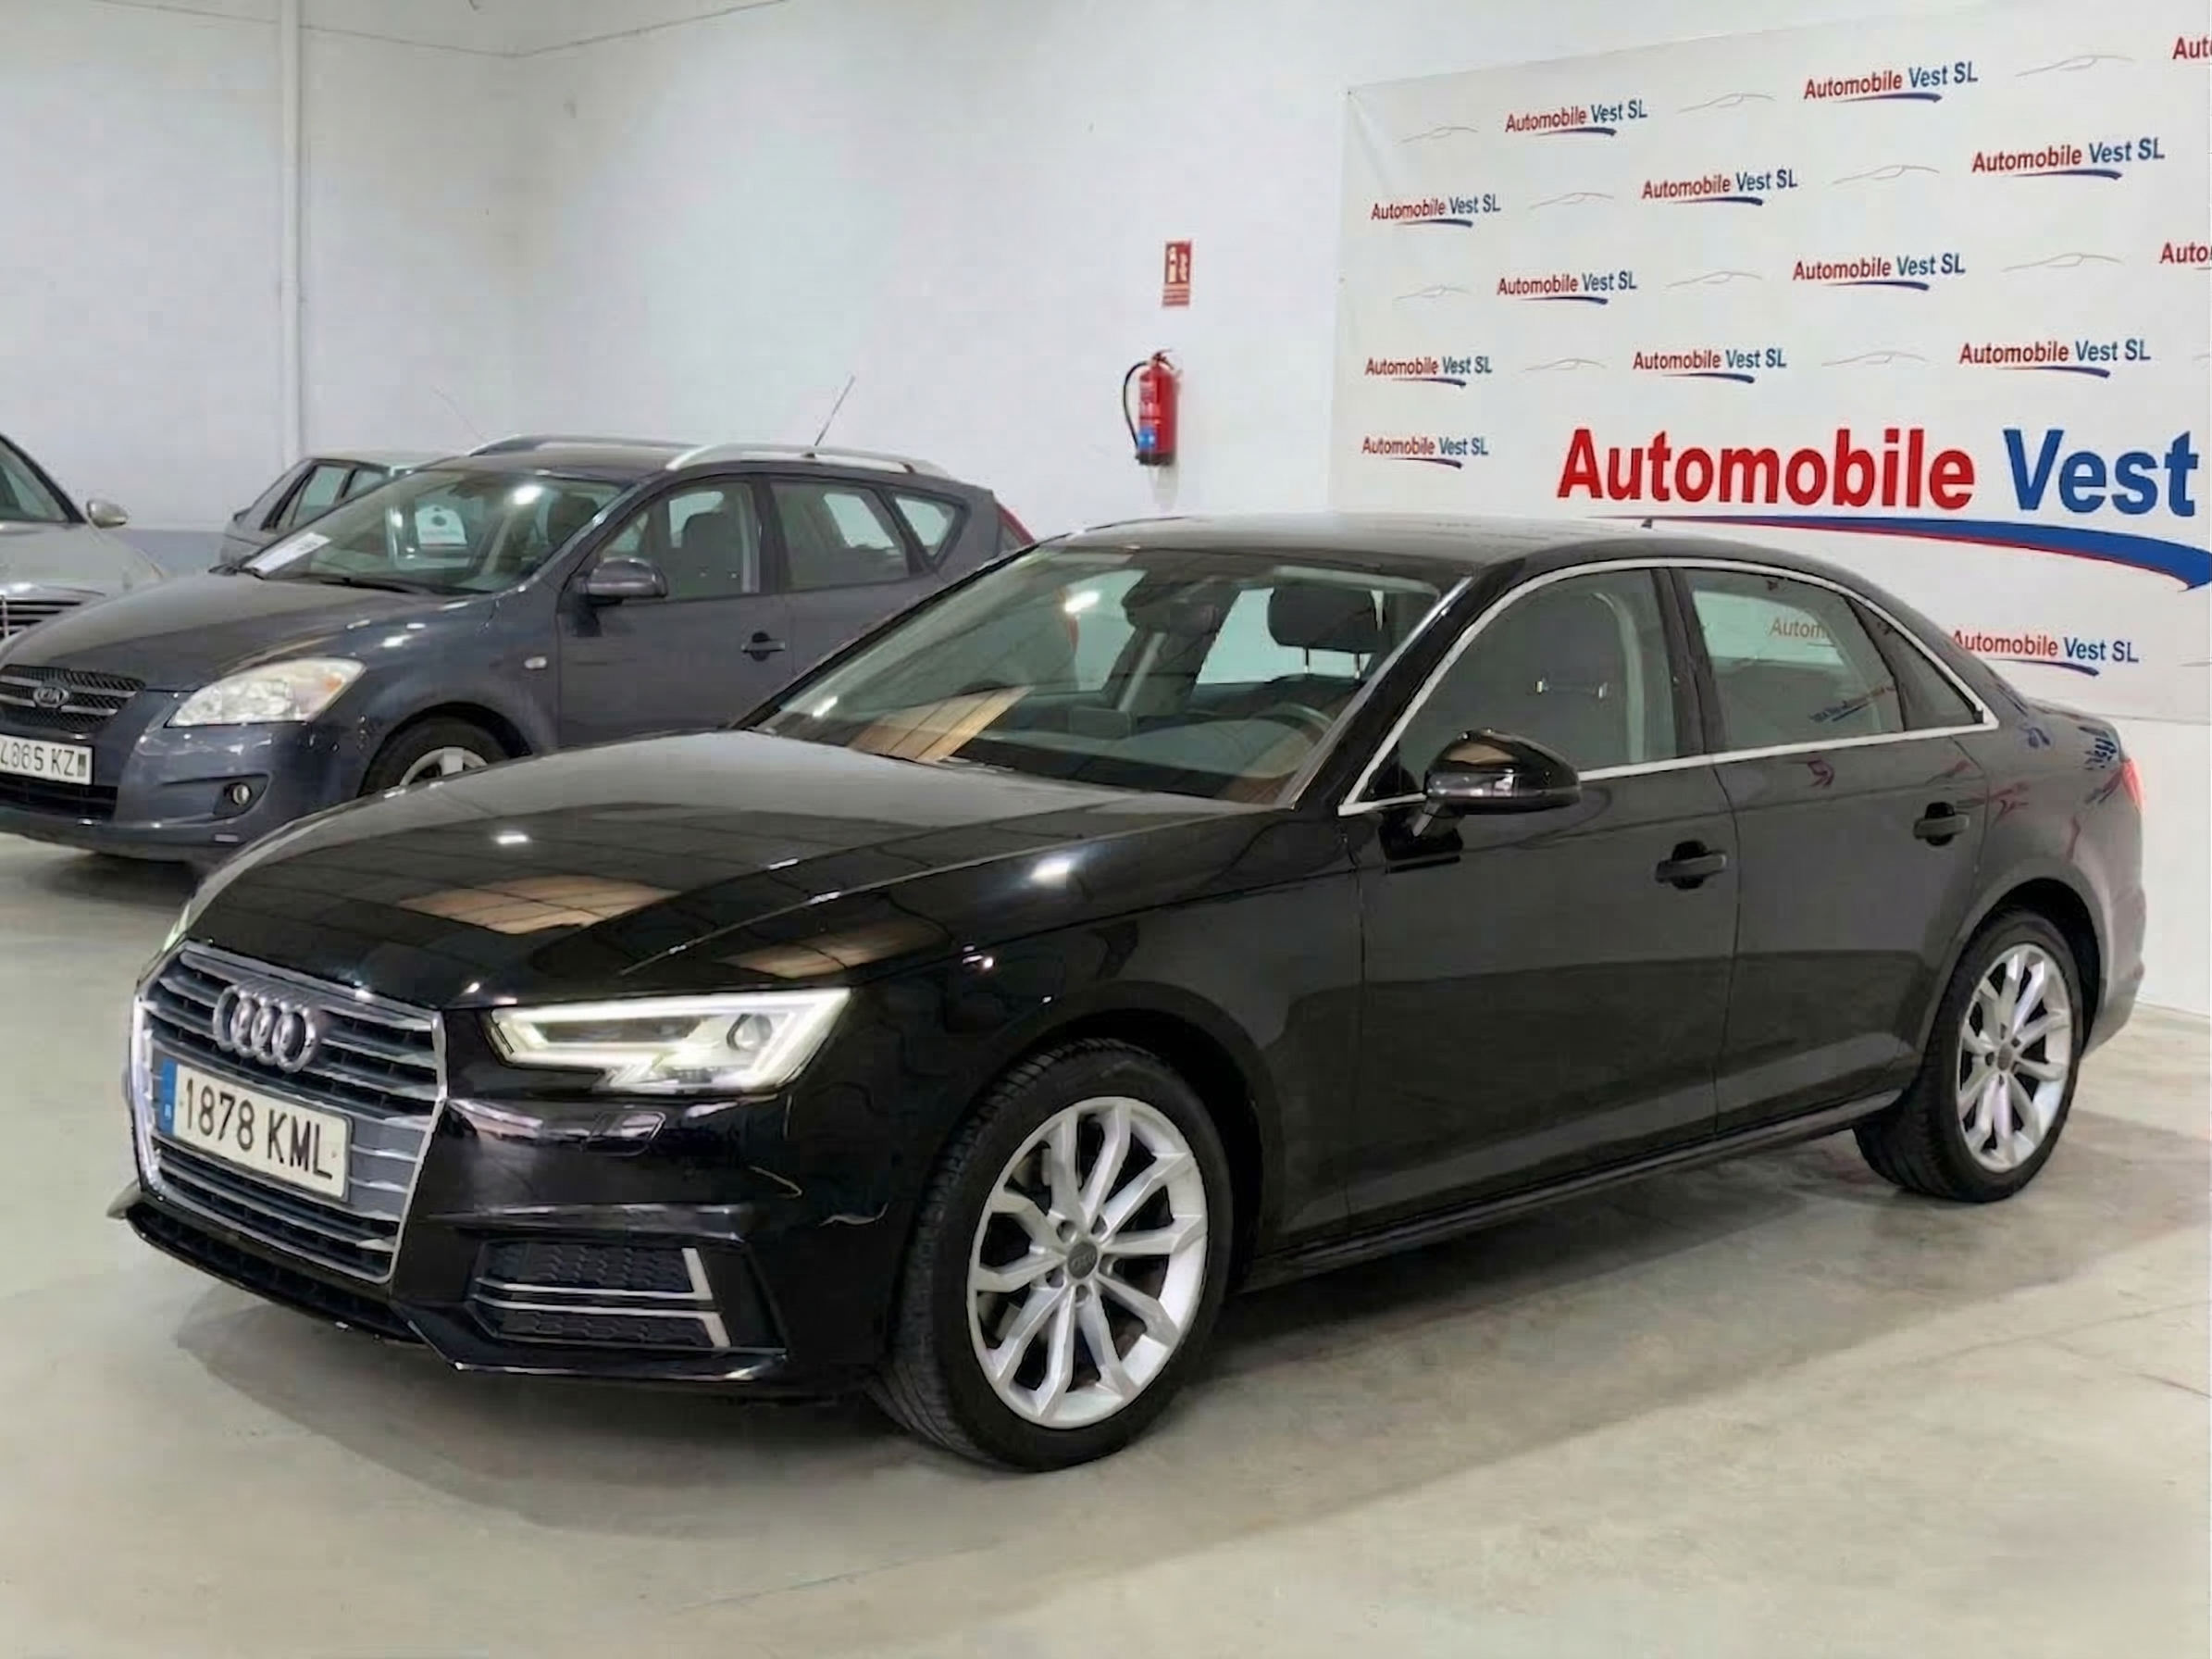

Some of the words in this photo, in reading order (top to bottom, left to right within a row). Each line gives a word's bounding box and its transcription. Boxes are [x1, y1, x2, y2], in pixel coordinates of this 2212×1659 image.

[2171, 36, 2212, 60] Aut
[1804, 70, 1903, 100] Automobile
[1908, 66, 1948, 88] Vest
[1953, 61, 1979, 84] SL
[1505, 105, 1587, 132] Automobile
[1591, 103, 1623, 123] Vest
[1627, 99, 1647, 119] SL
[1971, 143, 2082, 173] Automobile
[2089, 140, 2132, 164] Vest
[2137, 137, 2165, 161] SL
[1641, 173, 1732, 199] Automobile
[1735, 170, 1771, 193] Vest
[1776, 168, 1798, 190] SL
[1371, 198, 1446, 220] Automobile
[1449, 195, 1479, 215] Vest
[1483, 193, 1501, 213] SL
[1793, 256, 1892, 281] Automobile
[1896, 254, 1936, 277] Vest
[1941, 252, 1966, 275] SL
[2159, 242, 2212, 265] Auto
[1497, 273, 1579, 295] Automobile
[1582, 272, 1614, 293] Vest
[1618, 269, 1637, 290] SL
[1633, 349, 1721, 370] Automobile
[1725, 348, 1760, 369] Vest
[1765, 347, 1787, 369] SL
[1958, 340, 2069, 364] Automobile
[2075, 339, 2119, 363] Vest
[2124, 337, 2152, 362] SL
[1365, 356, 1439, 376] Automobile
[1442, 356, 1471, 375] Vest
[1474, 355, 1493, 375] SL
[1361, 436, 1435, 456] Automobile
[1438, 436, 1468, 456] Vest
[1471, 436, 1489, 456] SL
[1555, 427, 1975, 511] Automobile
[2001, 427, 2200, 518] Vest
[2063, 637, 2106, 662] Vest
[2111, 640, 2140, 663] SL
[185, 1079, 255, 1152] 1878
[267, 1108, 333, 1180] KML
